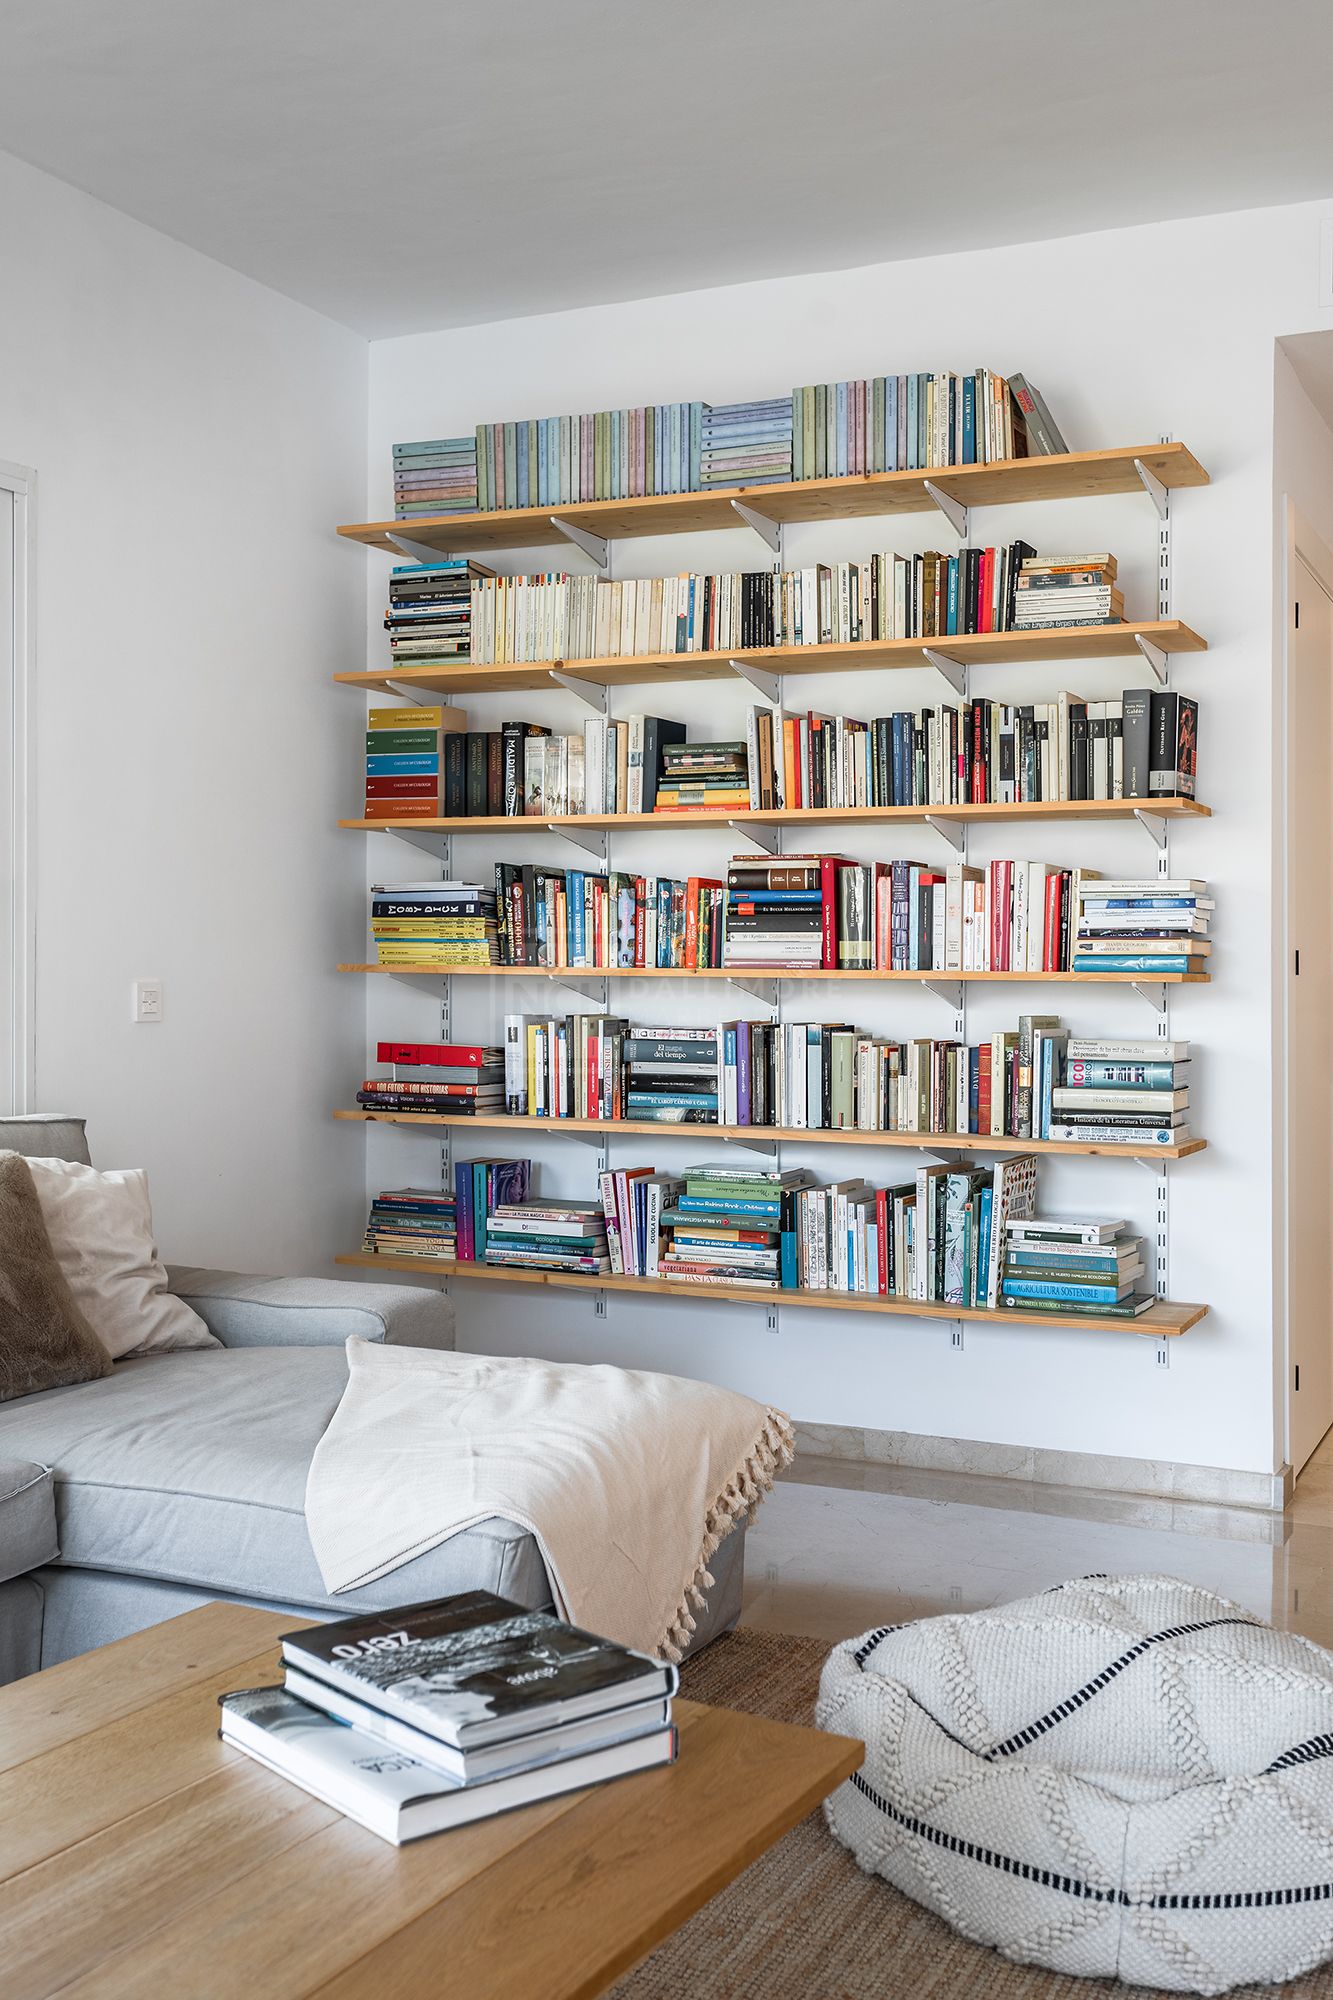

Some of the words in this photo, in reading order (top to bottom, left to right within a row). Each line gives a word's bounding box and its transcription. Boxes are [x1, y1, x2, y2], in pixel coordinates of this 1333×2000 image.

[508, 740, 516, 778] MALDITA
[508, 781, 516, 808] ROMA
[388, 905, 422, 914] MOBY
[424, 905, 459, 913] DICK
[514, 922, 522, 945] 1000
[377, 1083, 387, 1091] 100
[387, 1084, 404, 1093] FOTOS
[409, 1084, 419, 1093] 100
[420, 1084, 449, 1094] HISTORIAS
[1139, 1118, 1166, 1126] Universal
[664, 1265, 697, 1273] vegetariana
[1016, 1284, 1061, 1296] AGRICULTURA
[1061, 1288, 1099, 1299] SOSTENIBLE
[330, 1629, 422, 1661] zero
[506, 1666, 558, 1687] above
